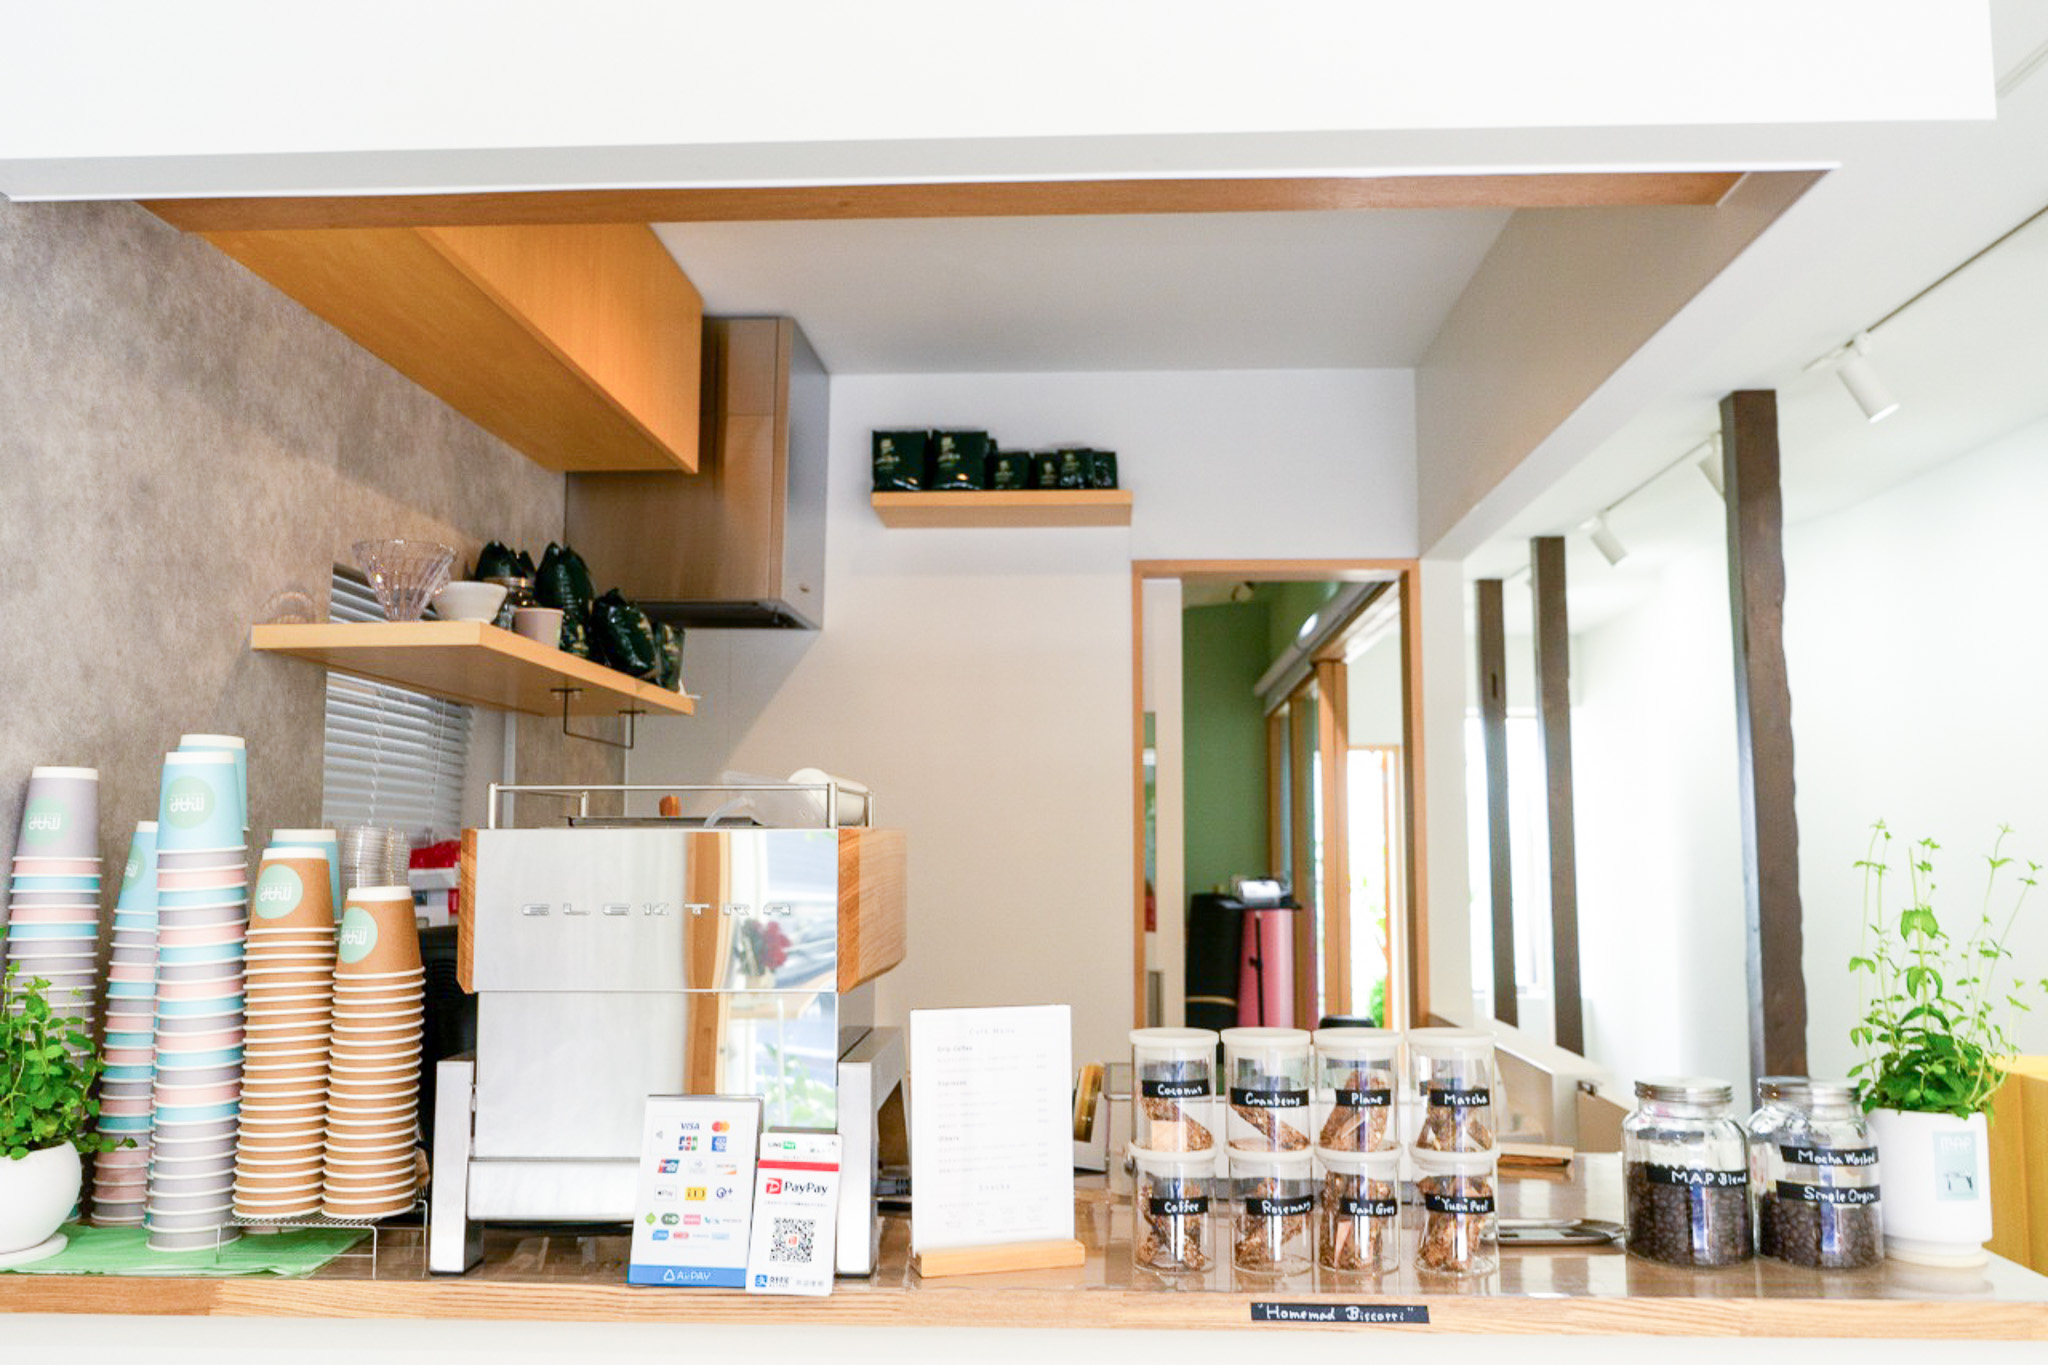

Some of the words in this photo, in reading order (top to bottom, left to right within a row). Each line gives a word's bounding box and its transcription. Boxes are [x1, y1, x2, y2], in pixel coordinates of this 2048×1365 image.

[521, 903, 792, 917] ELEKTRA
[1157, 1083, 1203, 1096] Coconut
[1444, 1093, 1488, 1105] Matcha
[681, 1122, 700, 1130] VISA
[1797, 1150, 1844, 1165] Mocha
[1718, 1172, 1747, 1185] Blend
[784, 1181, 829, 1196] PayPay
[1164, 1200, 1200, 1213] Coffee
